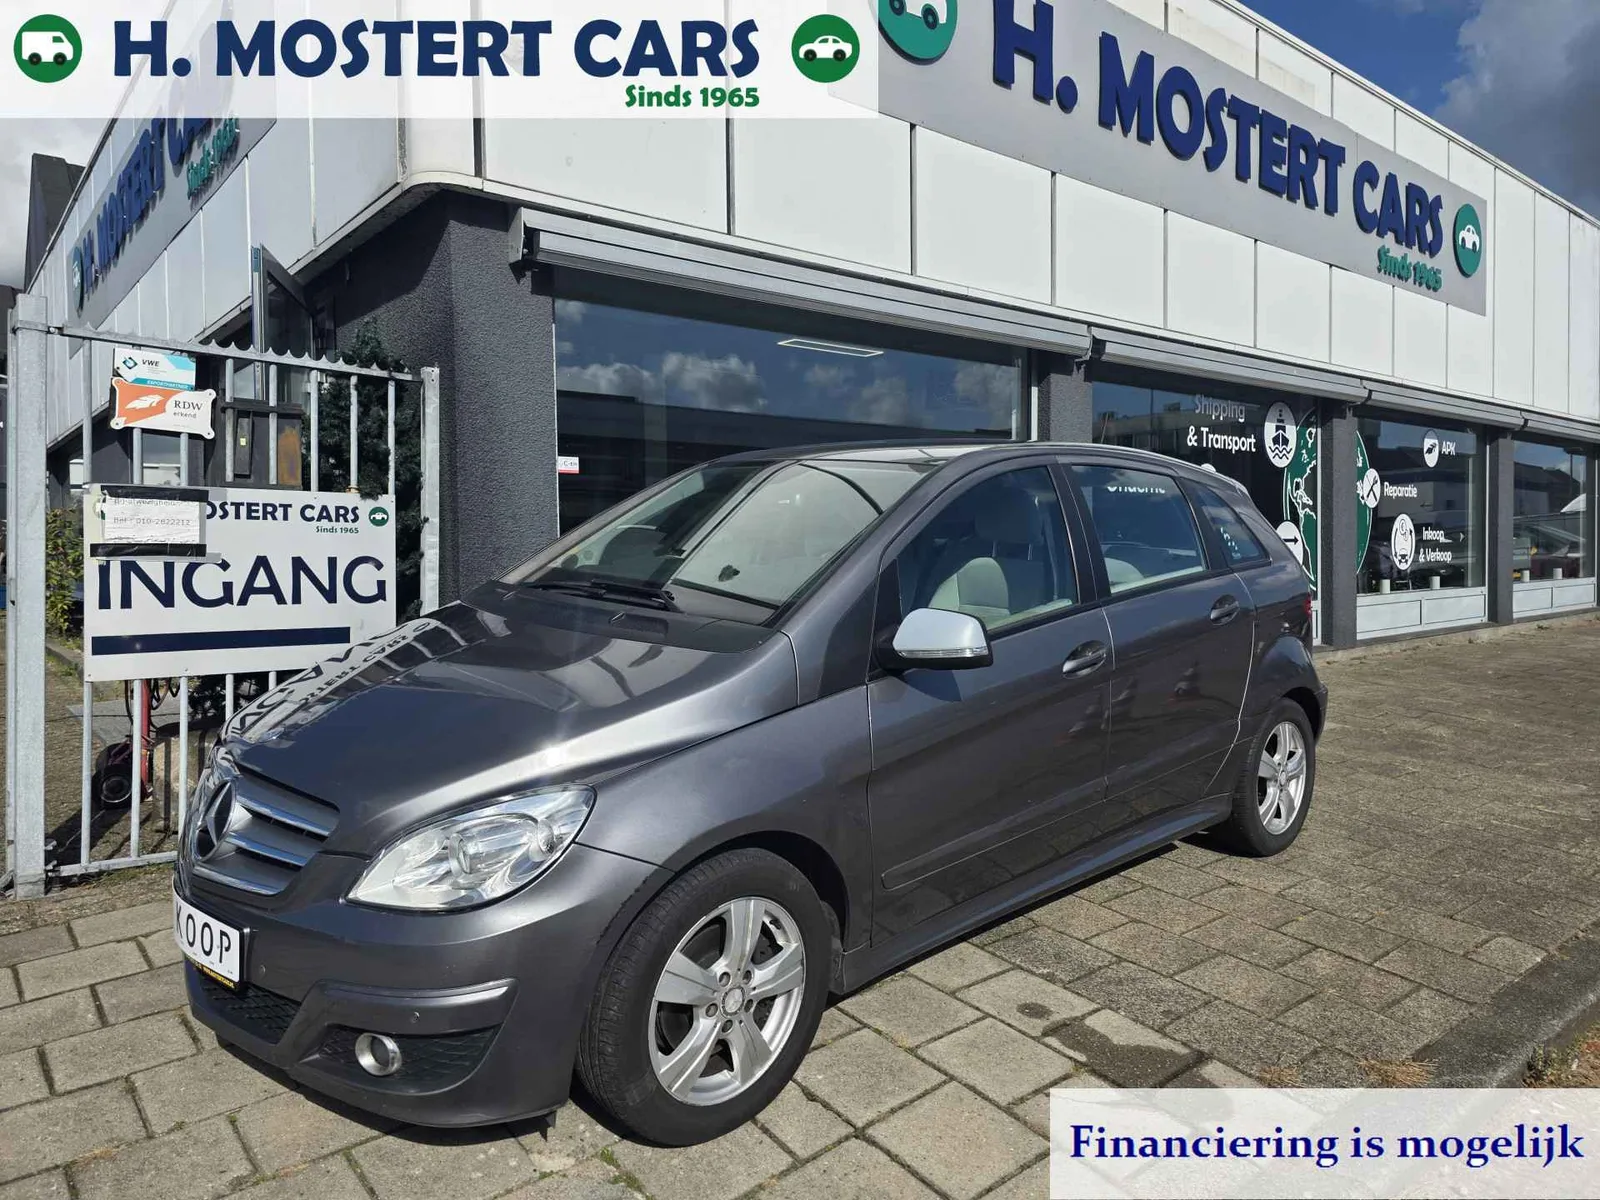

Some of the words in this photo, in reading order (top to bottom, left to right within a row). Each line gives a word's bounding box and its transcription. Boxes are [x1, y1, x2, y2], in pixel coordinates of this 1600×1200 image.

[992, 0, 1079, 113] H.
[1098, 31, 1346, 217] MOSTERT
[1352, 160, 1444, 259] CARS
[1377, 245, 1412, 283] Sinds
[1413, 261, 1443, 292] 1965
[141, 359, 160, 367] VWE
[173, 411, 197, 419] erkend
[174, 400, 203, 411] RDW
[1195, 394, 1246, 423] Shipping
[1187, 425, 1198, 447] &
[1200, 427, 1256, 454] Transport
[1441, 441, 1456, 455] APK
[1383, 481, 1418, 499] Reparatie
[206, 500, 293, 521] OSTERT
[299, 503, 361, 524] CARS
[315, 525, 338, 534] Sinds
[339, 526, 360, 535] 1965
[1426, 547, 1453, 564] Verkoop
[97, 555, 388, 610] INGANG
[176, 901, 231, 963] KOOP
